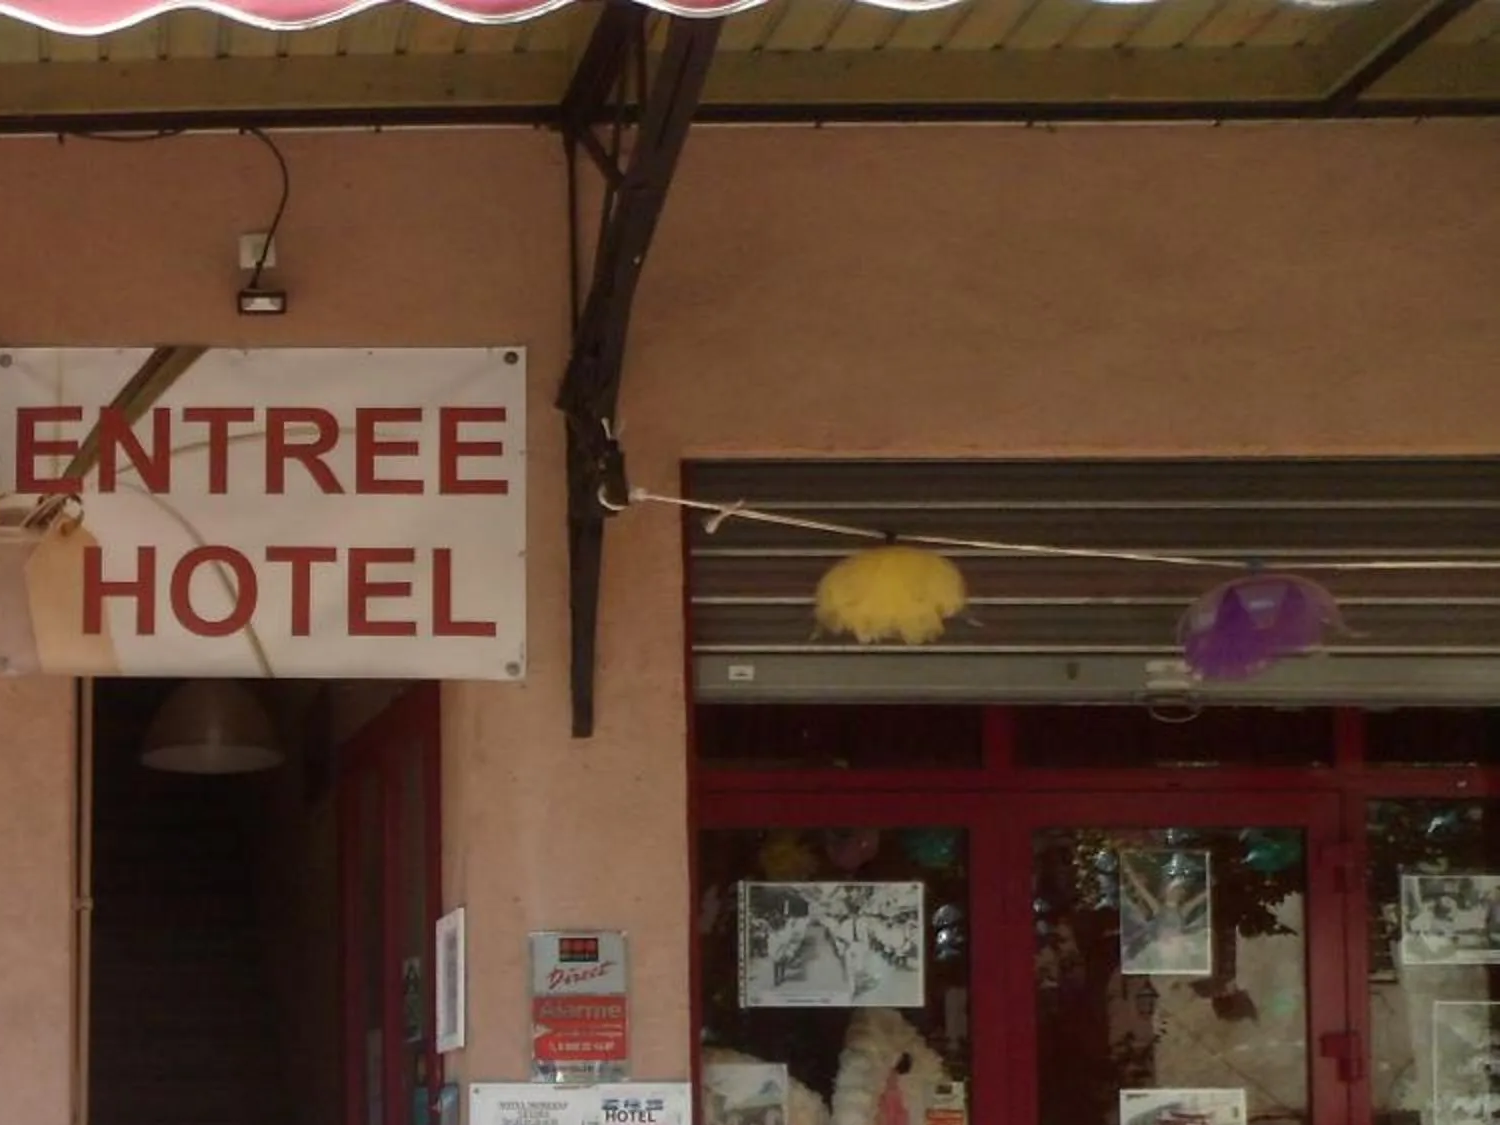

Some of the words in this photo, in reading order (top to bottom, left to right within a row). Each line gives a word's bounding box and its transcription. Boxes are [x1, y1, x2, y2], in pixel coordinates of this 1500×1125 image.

[15, 405, 509, 496] ENTREE
[81, 545, 498, 638] HOTEL
[604, 1110, 657, 1123] HOTEL
